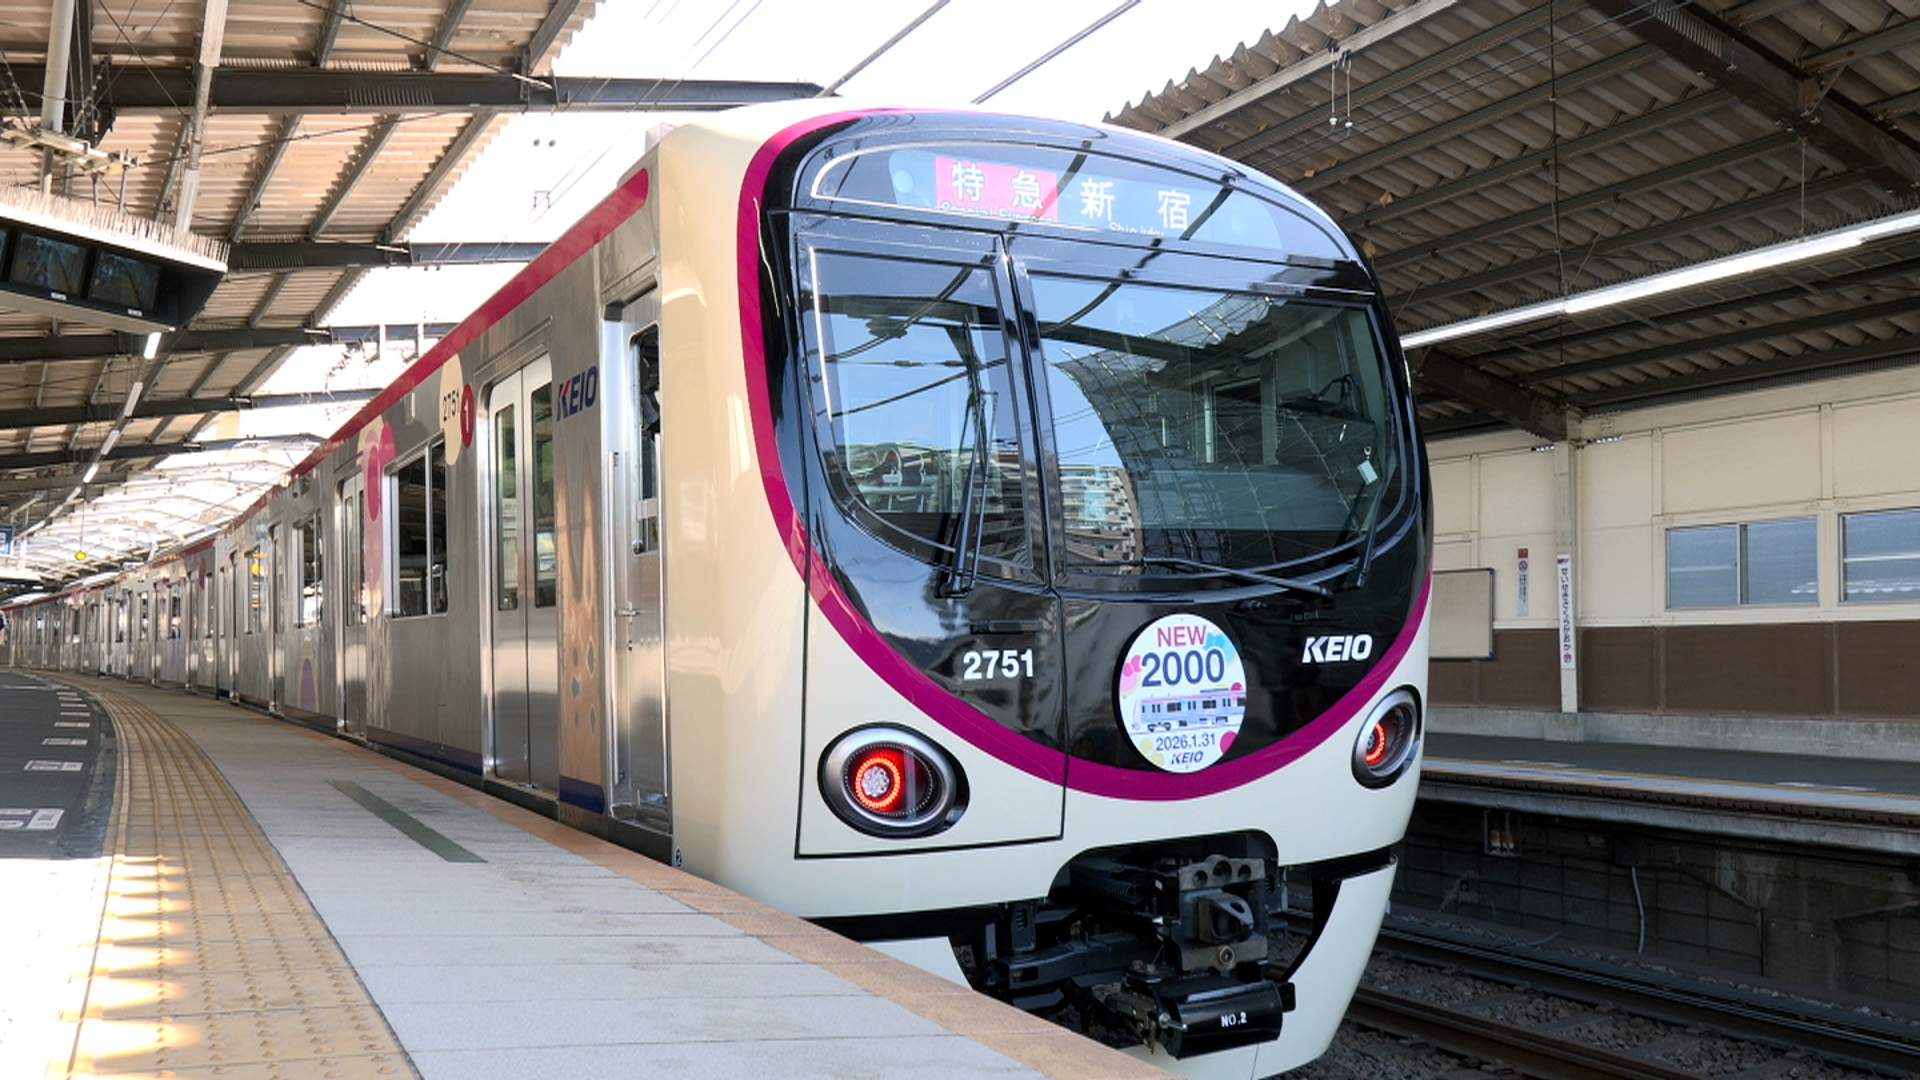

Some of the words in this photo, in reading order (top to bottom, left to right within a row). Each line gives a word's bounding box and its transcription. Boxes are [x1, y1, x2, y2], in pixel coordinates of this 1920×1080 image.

[951, 161, 1043, 210] 特急
[1080, 178, 1190, 230] 新宿
[442, 388, 460, 422] 2751
[556, 366, 598, 422] KEIO
[464, 399, 470, 433] 1
[1157, 625, 1207, 647] NEW
[1302, 633, 1373, 664] KEIO
[963, 648, 1034, 680] 2751
[1141, 648, 1225, 688] 2000
[1155, 733, 1216, 752] 2026.1.31
[1171, 751, 1204, 765] KEIO
[1221, 1012, 1247, 1027] NO.2
